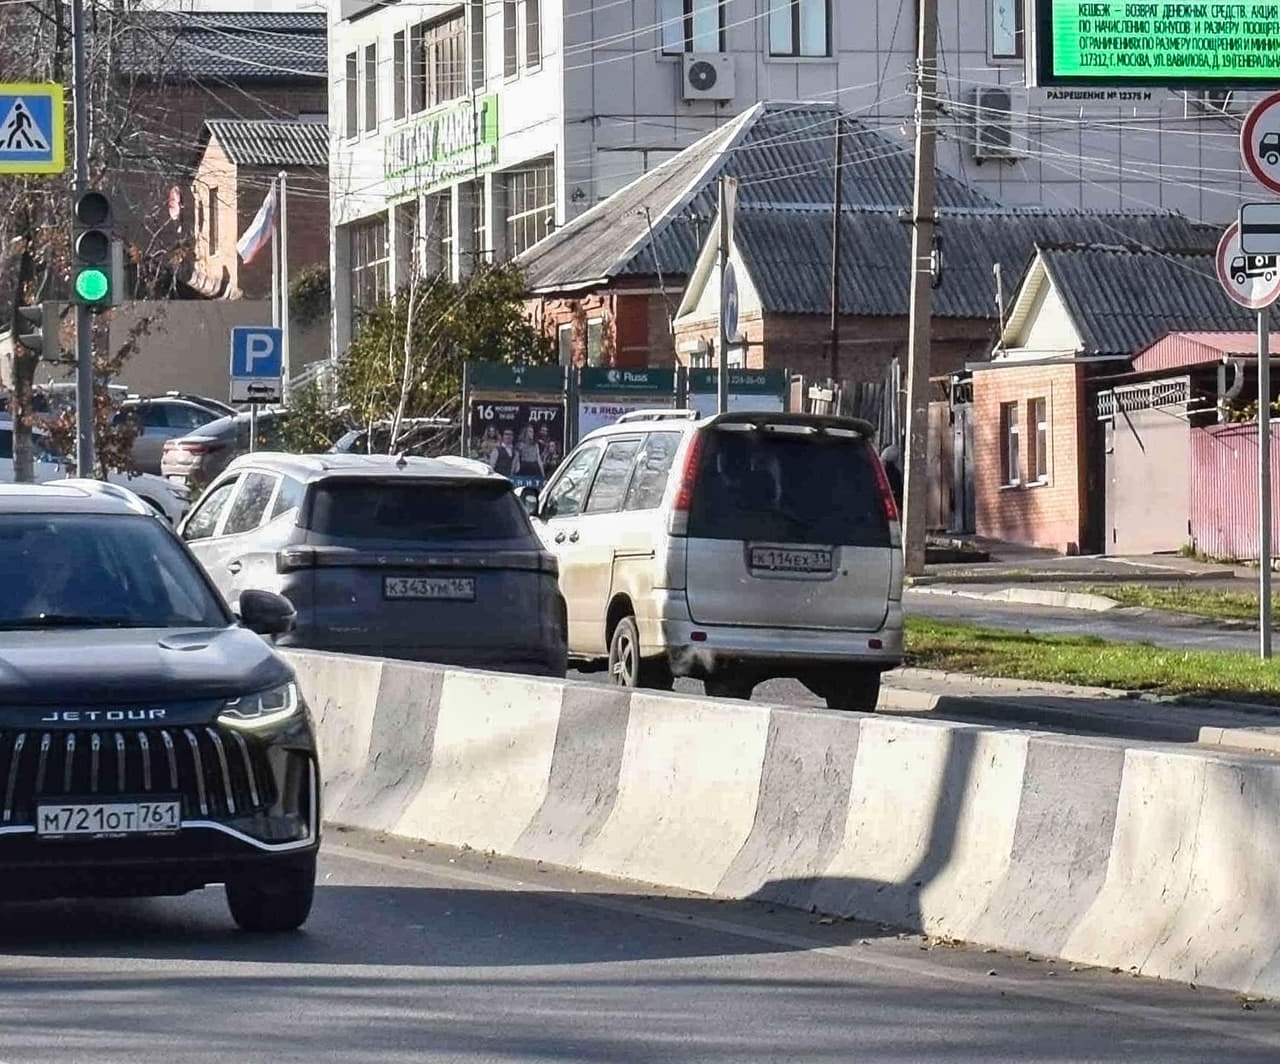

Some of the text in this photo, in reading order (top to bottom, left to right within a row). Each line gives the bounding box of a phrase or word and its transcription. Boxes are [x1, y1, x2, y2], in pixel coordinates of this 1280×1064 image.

[1046, 90, 1105, 100] РАЗРЕШЕНИЕ
[245, 333, 274, 373] P
[477, 405, 494, 420] 16
[528, 409, 557, 422] ДГТУ
[41, 708, 167, 721] JETOUR
[140, 804, 176, 824] 761
